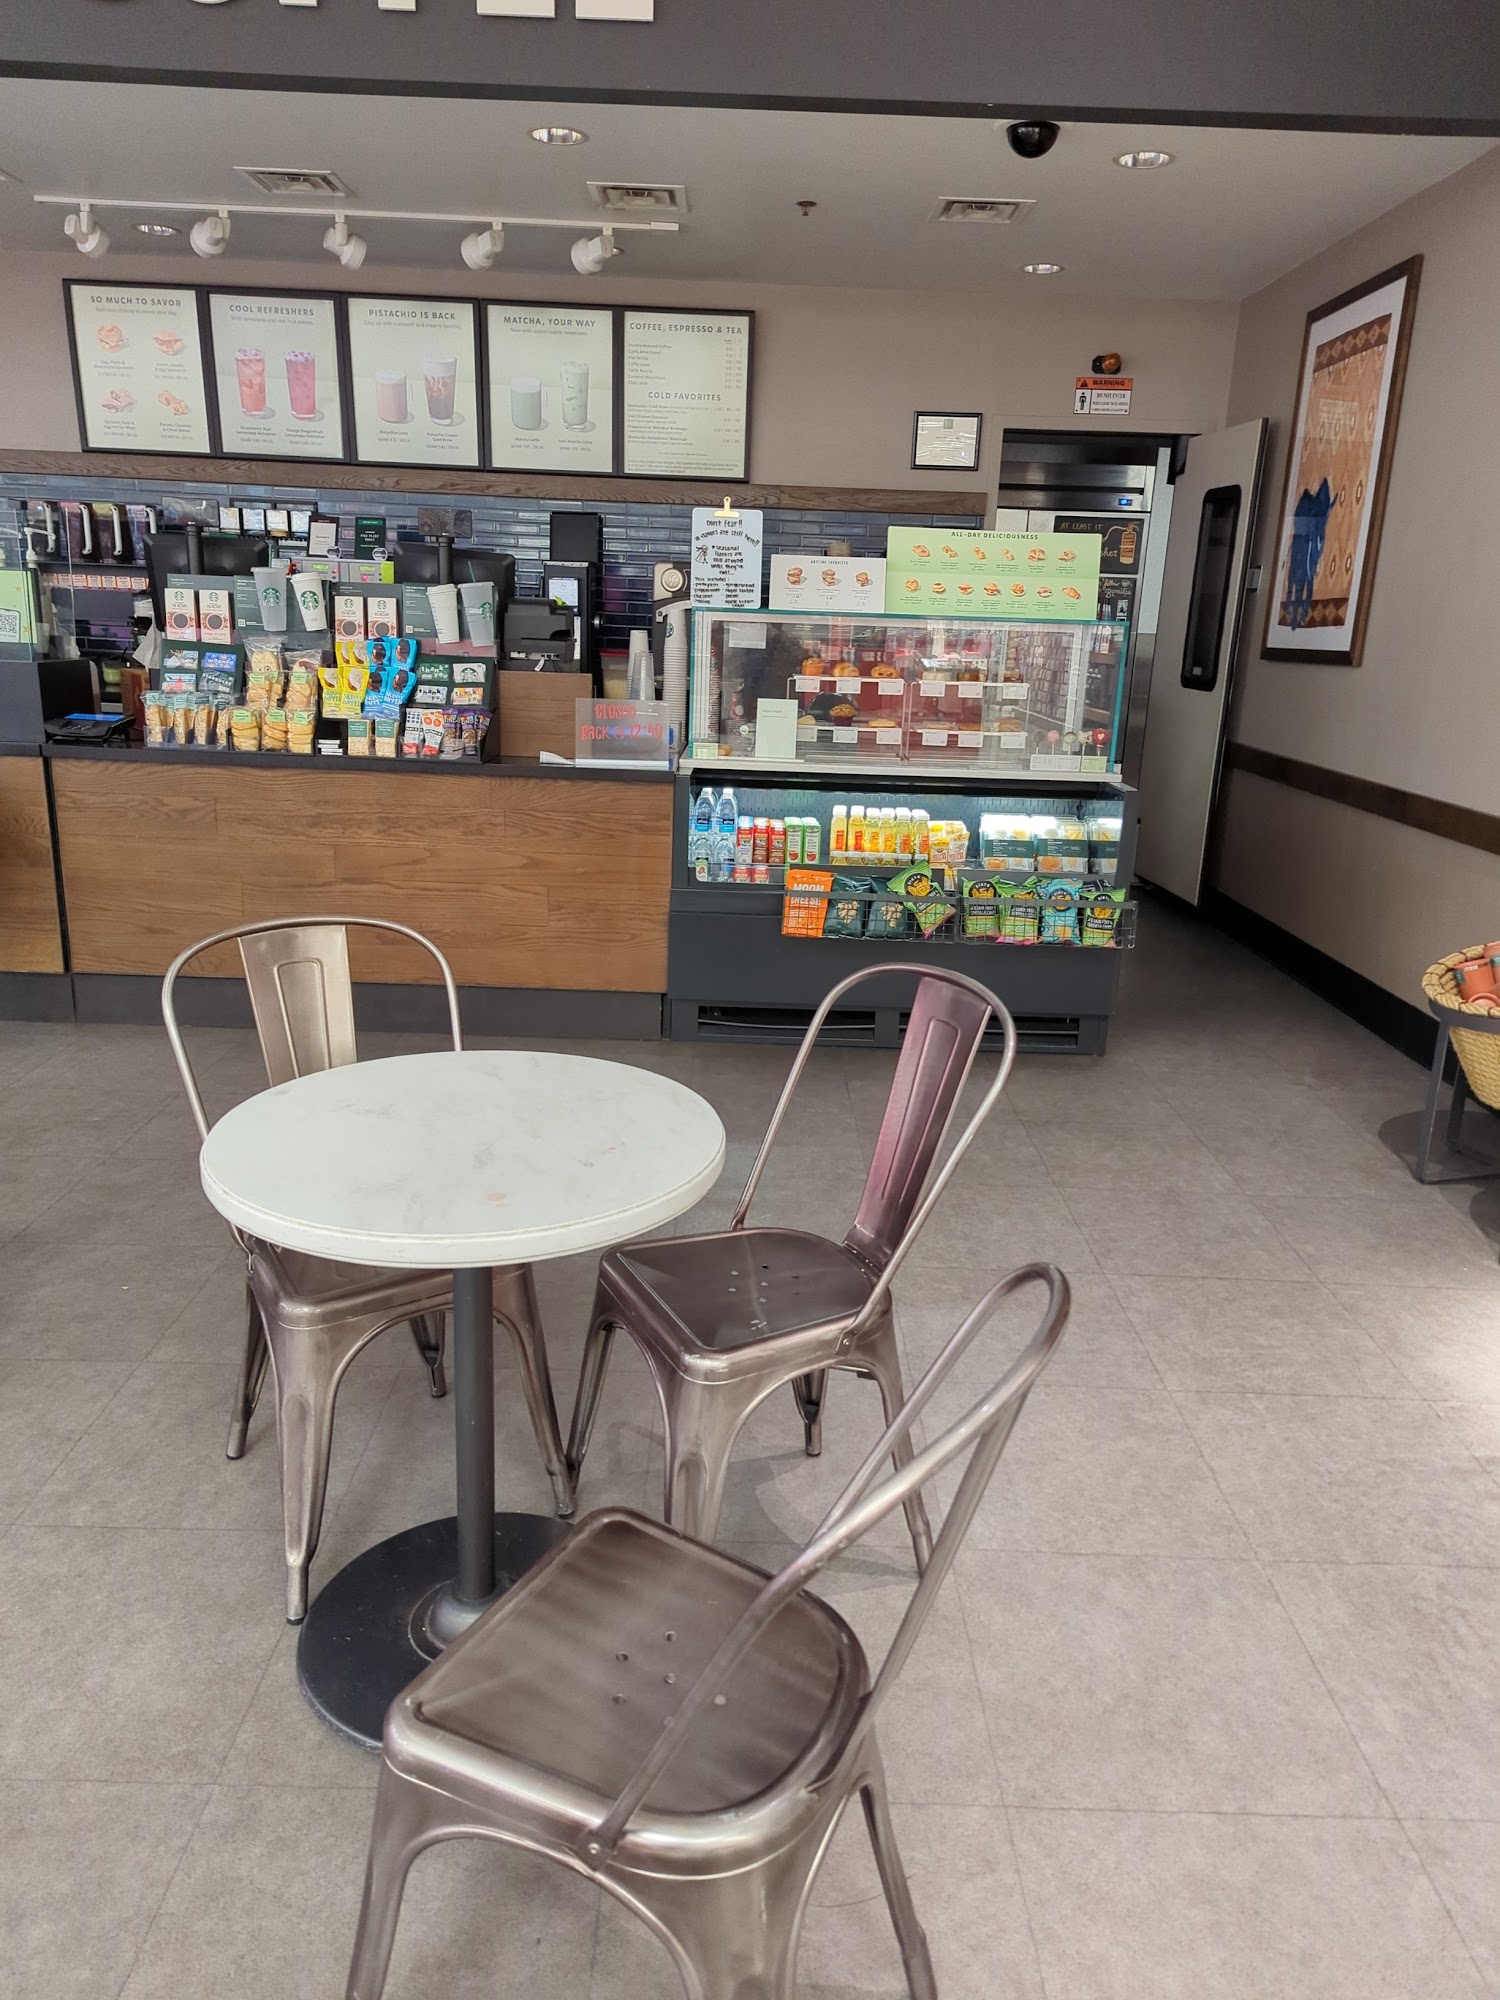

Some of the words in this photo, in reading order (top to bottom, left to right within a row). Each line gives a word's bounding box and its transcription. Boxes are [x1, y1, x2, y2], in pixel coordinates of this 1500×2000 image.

[151, 299, 181, 307] SAVOR
[258, 307, 314, 316] REFRESHERS
[369, 309, 417, 318] PISTACHIO
[432, 312, 455, 320] BACK
[504, 316, 545, 326] MATCHA,
[548, 318, 572, 326] YOUR
[630, 323, 666, 332] COFFEE,
[669, 324, 713, 333] ESPRESSO
[675, 393, 721, 401] FAVORITES
[421, 665, 444, 673] thank
[594, 703, 636, 719] CLOSED
[613, 726, 625, 740] @
[908, 875, 921, 885] SIETE
